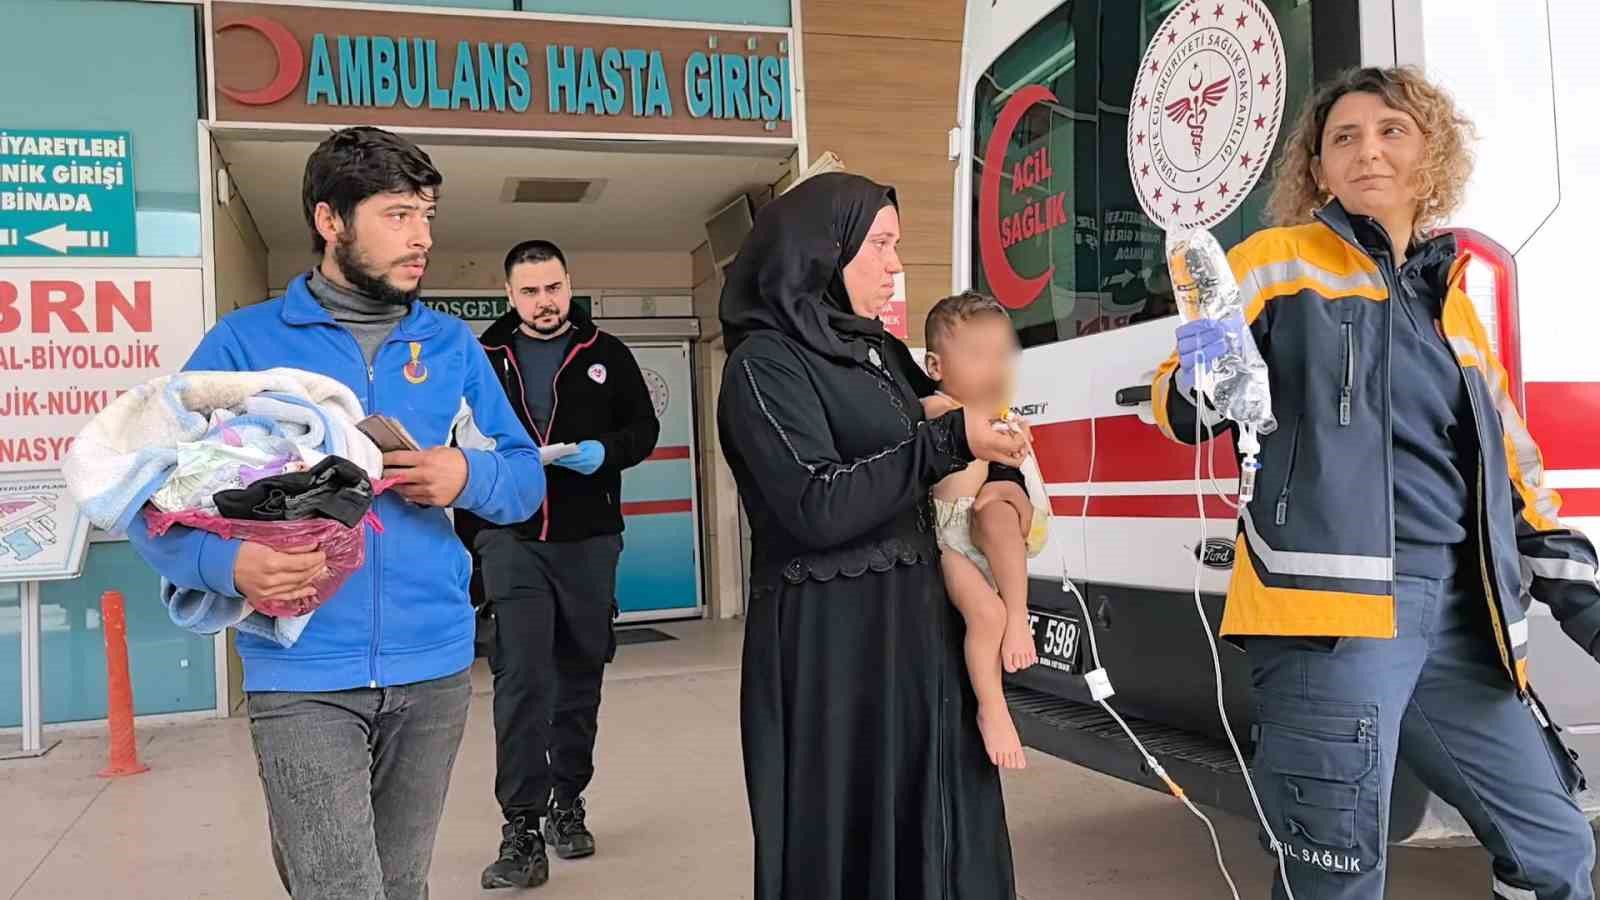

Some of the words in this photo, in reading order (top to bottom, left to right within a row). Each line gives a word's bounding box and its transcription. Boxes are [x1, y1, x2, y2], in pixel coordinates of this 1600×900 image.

[307, 33, 530, 113] AMBULANS
[546, 43, 672, 117] HASTA
[685, 35, 791, 130] GİRİŞİ
[0, 132, 126, 158] İYARETLERİ
[0, 159, 46, 185] NİK
[52, 160, 124, 190] GİRİŞİ
[1, 187, 93, 212] BİNADA
[1000, 192, 1068, 249] SAĞLIK
[1203, 544, 1230, 562] Ford
[1044, 619, 1076, 658] 598
[1302, 849, 1361, 872] SAĞLIK
